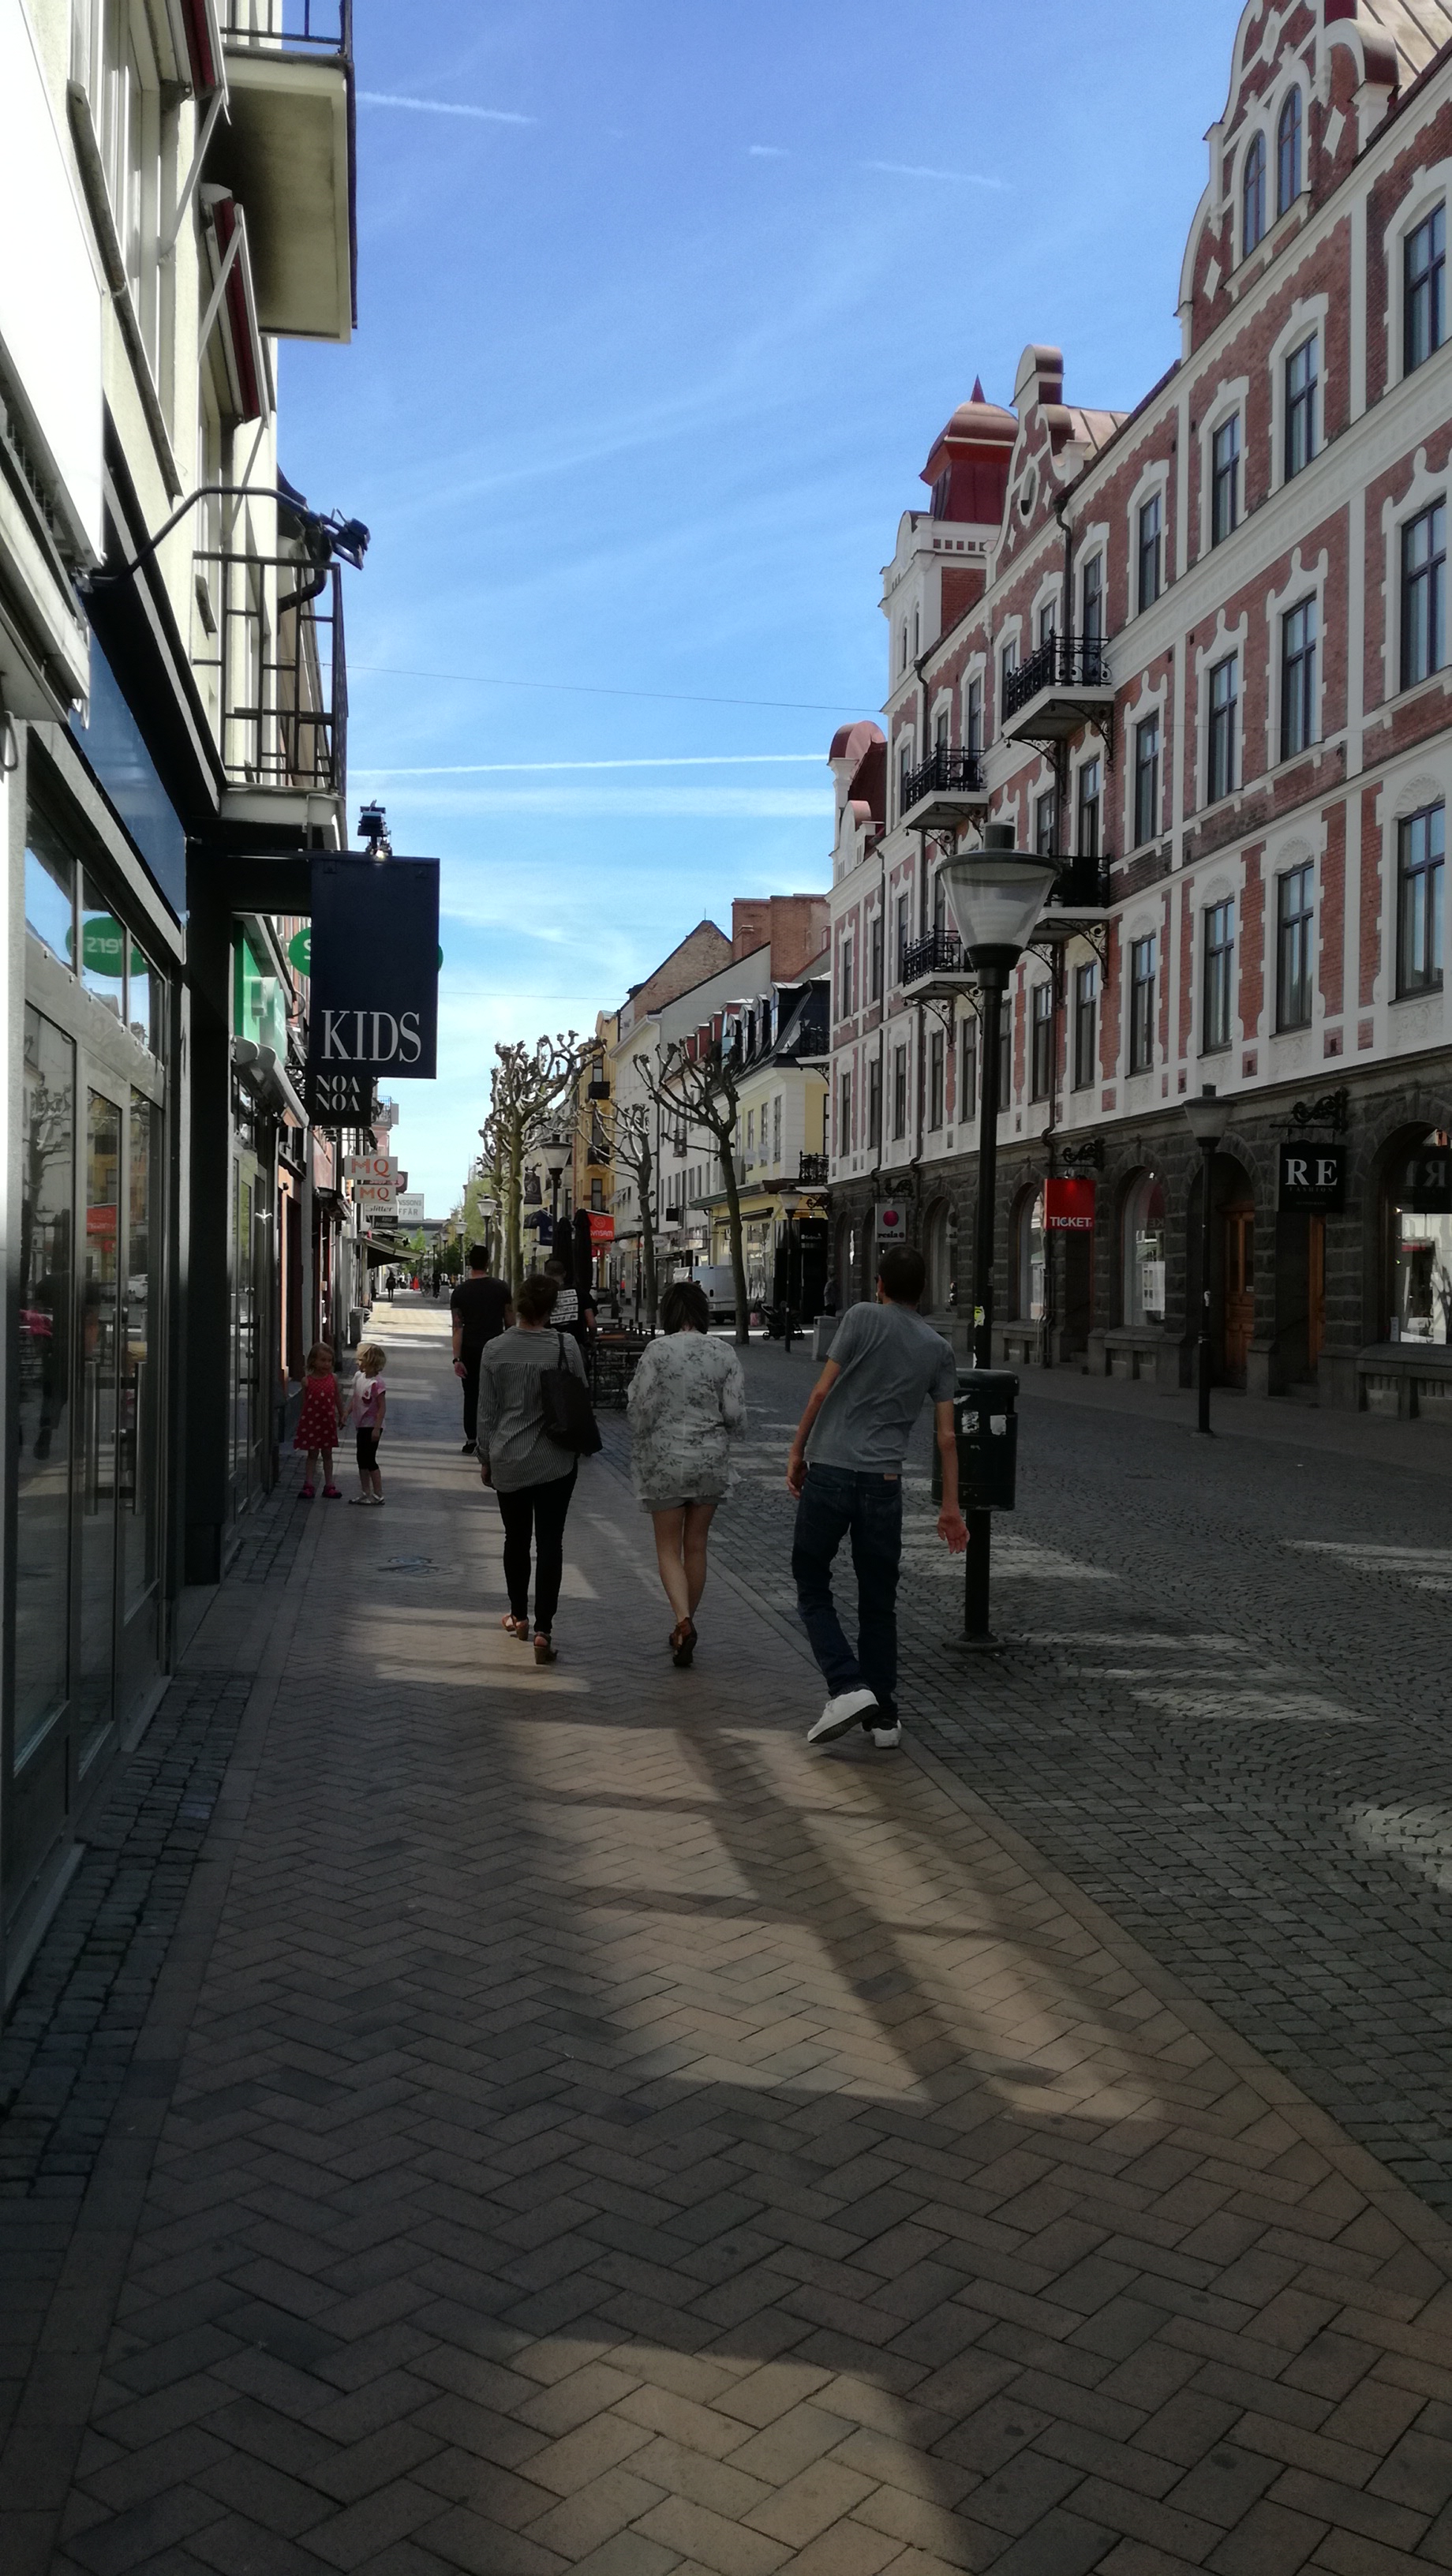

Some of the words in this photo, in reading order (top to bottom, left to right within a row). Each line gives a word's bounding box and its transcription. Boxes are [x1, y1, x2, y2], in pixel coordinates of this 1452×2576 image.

[321, 1010, 422, 1063] KIDS
[316, 1075, 361, 1093] NOA
[315, 1094, 361, 1112] NOA
[351, 1159, 391, 1178] MQ
[1285, 1159, 1338, 1186] RE
[360, 1187, 391, 1202] MQ
[1049, 1216, 1091, 1227] TICKET
